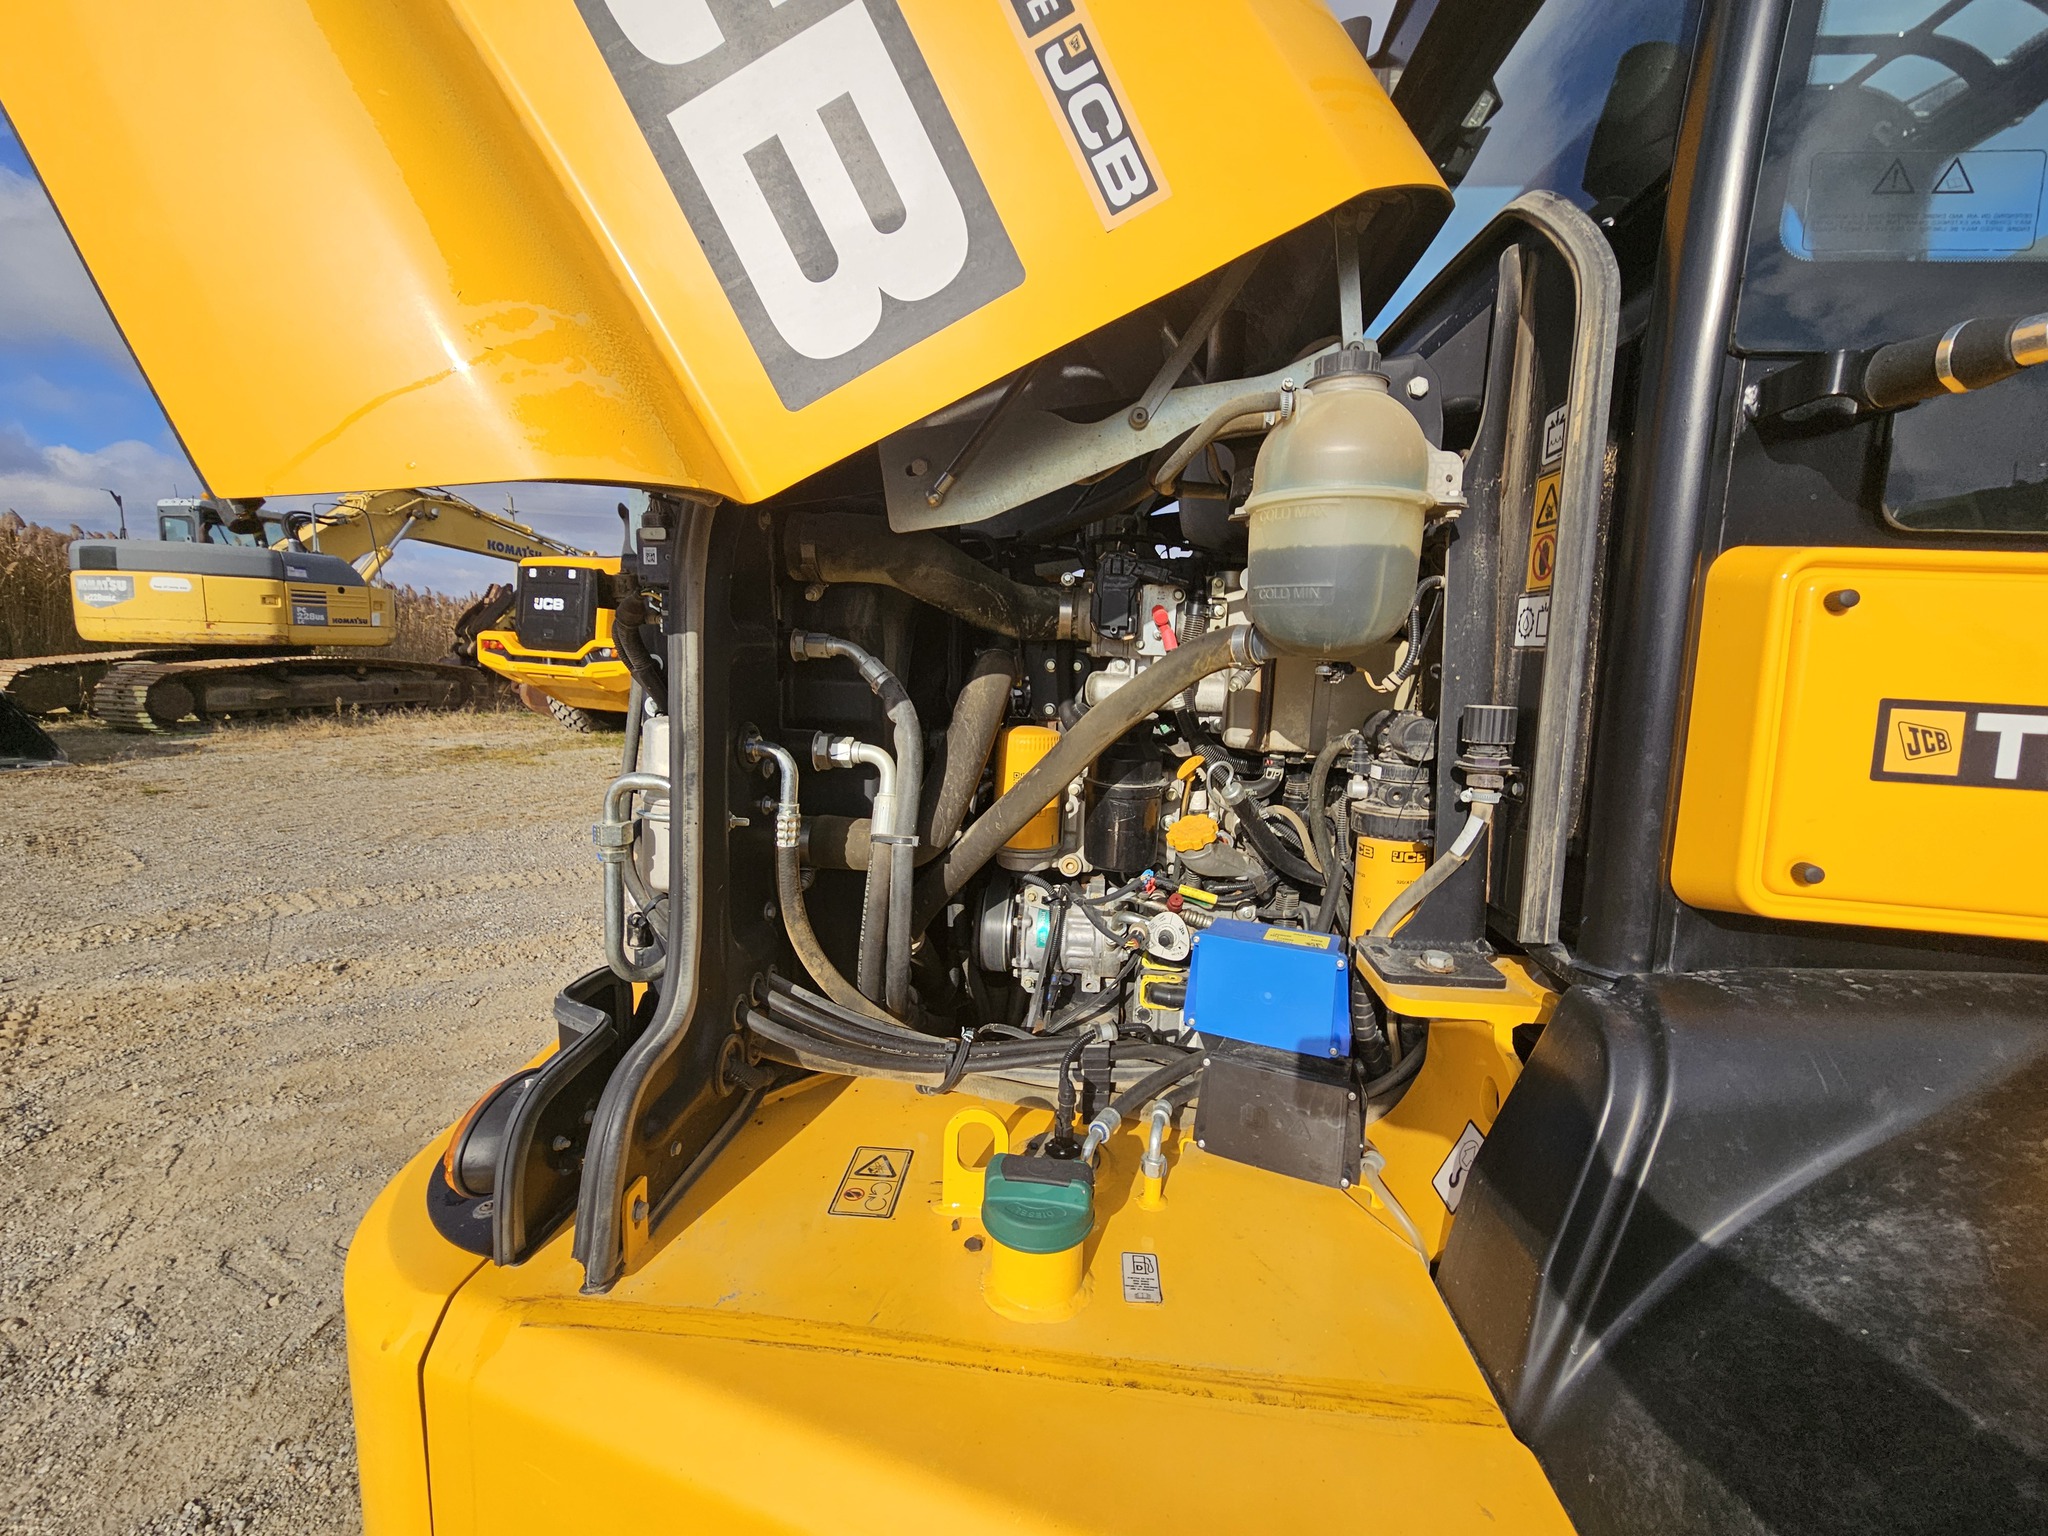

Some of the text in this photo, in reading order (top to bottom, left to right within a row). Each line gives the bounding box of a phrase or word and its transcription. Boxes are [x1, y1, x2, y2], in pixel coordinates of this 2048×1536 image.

[1044, 42, 1149, 207] JCB
[1260, 505, 1329, 522] COLD MAX
[1259, 587, 1321, 600] COLD MIN
[534, 598, 564, 611] JCB
[1907, 726, 1948, 756] JCB
[1359, 844, 1374, 858] CB
[1016, 1206, 1055, 1219] DIESEL
